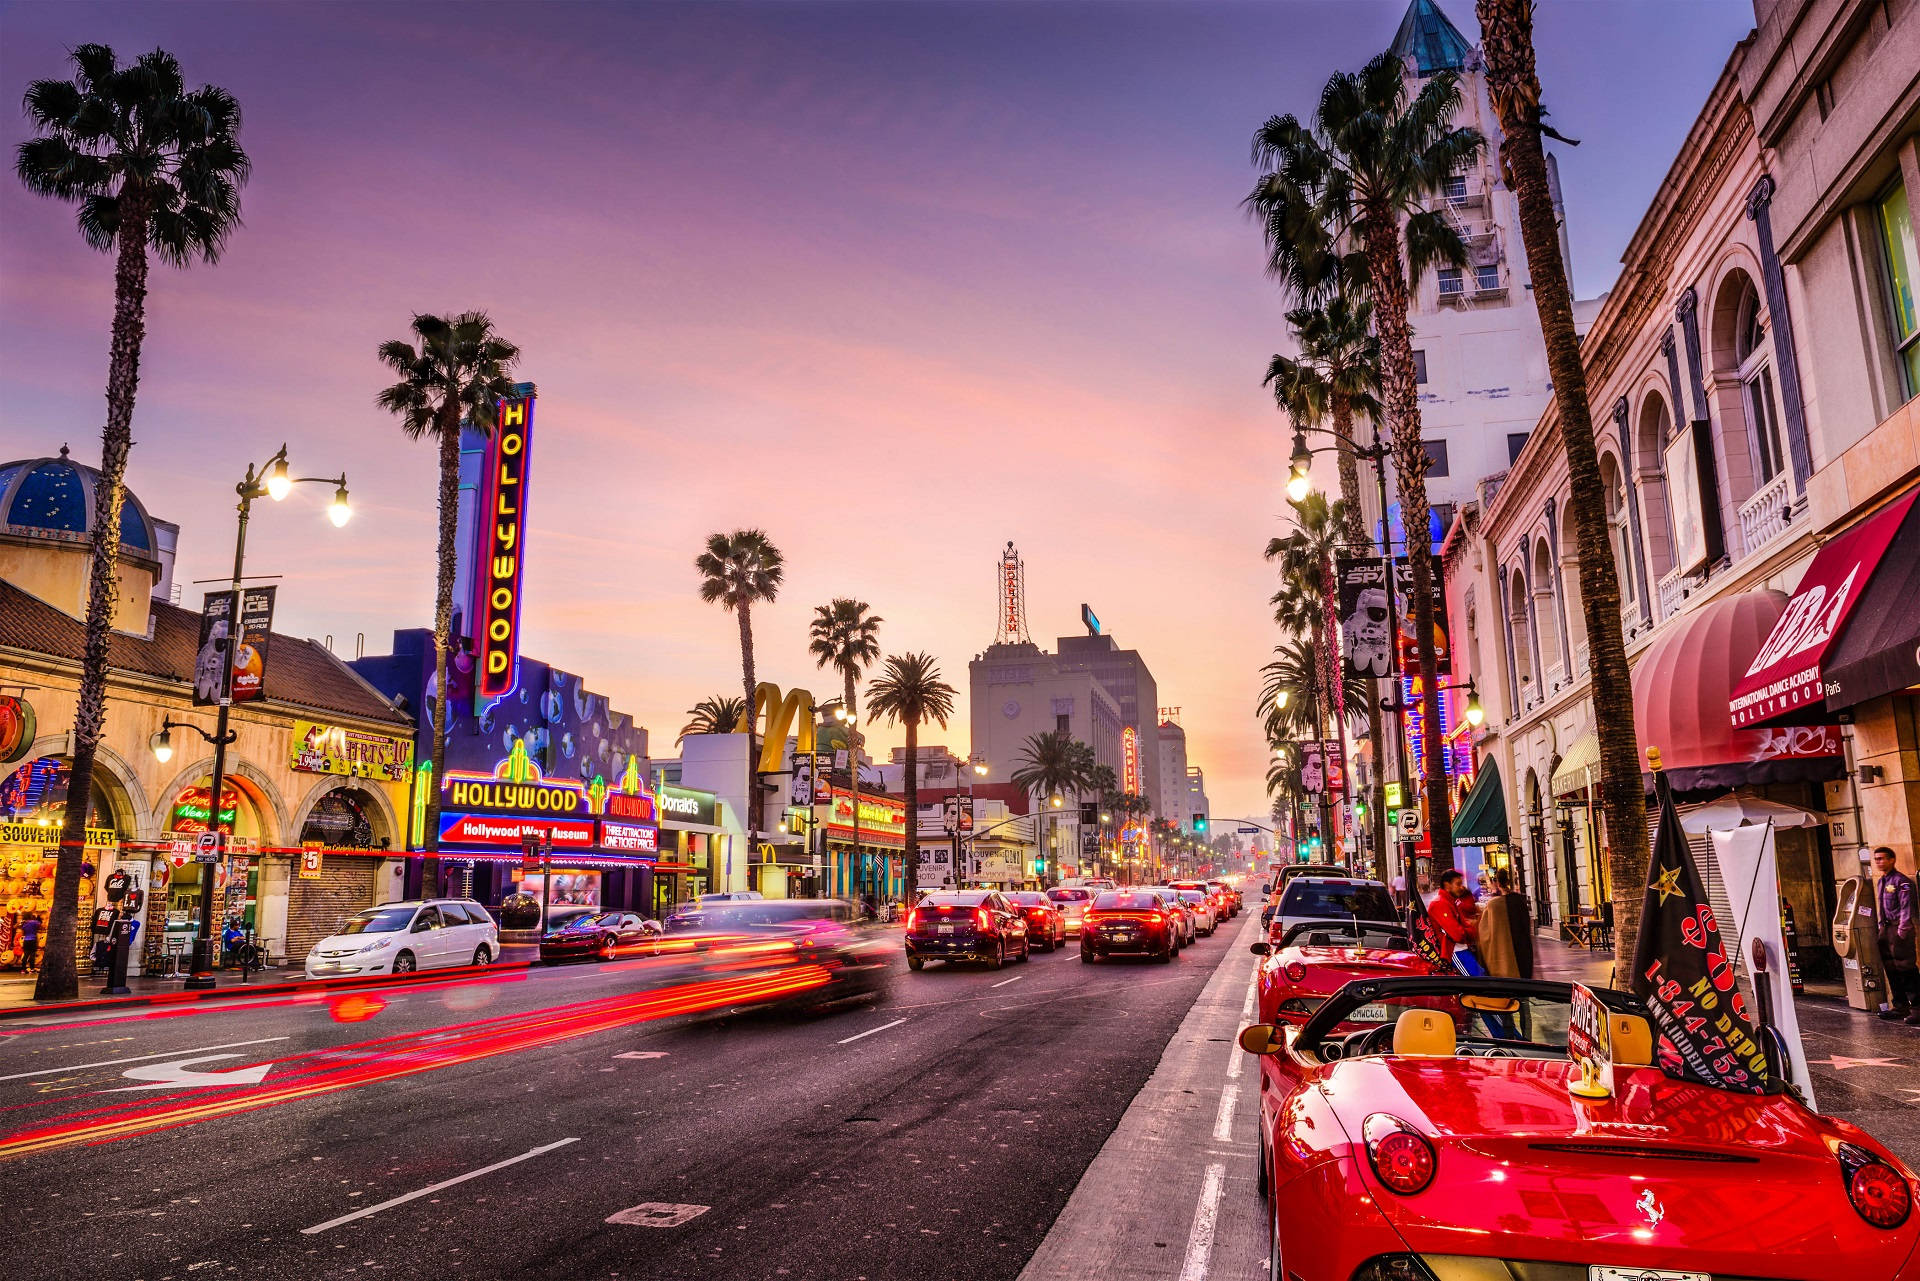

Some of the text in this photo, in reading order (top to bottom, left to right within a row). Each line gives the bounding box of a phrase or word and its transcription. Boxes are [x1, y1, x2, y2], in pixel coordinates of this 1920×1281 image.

[489, 403, 523, 674] HOLLYWOOD
[1729, 665, 1819, 712] INTERNATIONAL DANCE ACADEMY
[1825, 680, 1841, 697] Paris
[1731, 682, 1823, 726] HOLLYWOOD
[452, 782, 577, 812] HOLLYWOOD
[611, 794, 651, 819] HOLLYWOOD
[2, 825, 63, 844] SOUVENI
[463, 822, 520, 838] Hollywood
[551, 826, 589, 840] Museum
[605, 825, 654, 838] THREE ATTRACTIONS
[1832, 822, 1845, 837] 6757
[173, 842, 191, 853] ATM
[604, 836, 654, 850] ONE TICKET PRICE!
[1455, 836, 1499, 845] CAMERAS GALORE
[303, 851, 318, 870] $5
[1688, 975, 1718, 1010] NO
[1352, 1009, 1384, 1019] 6MWC464
